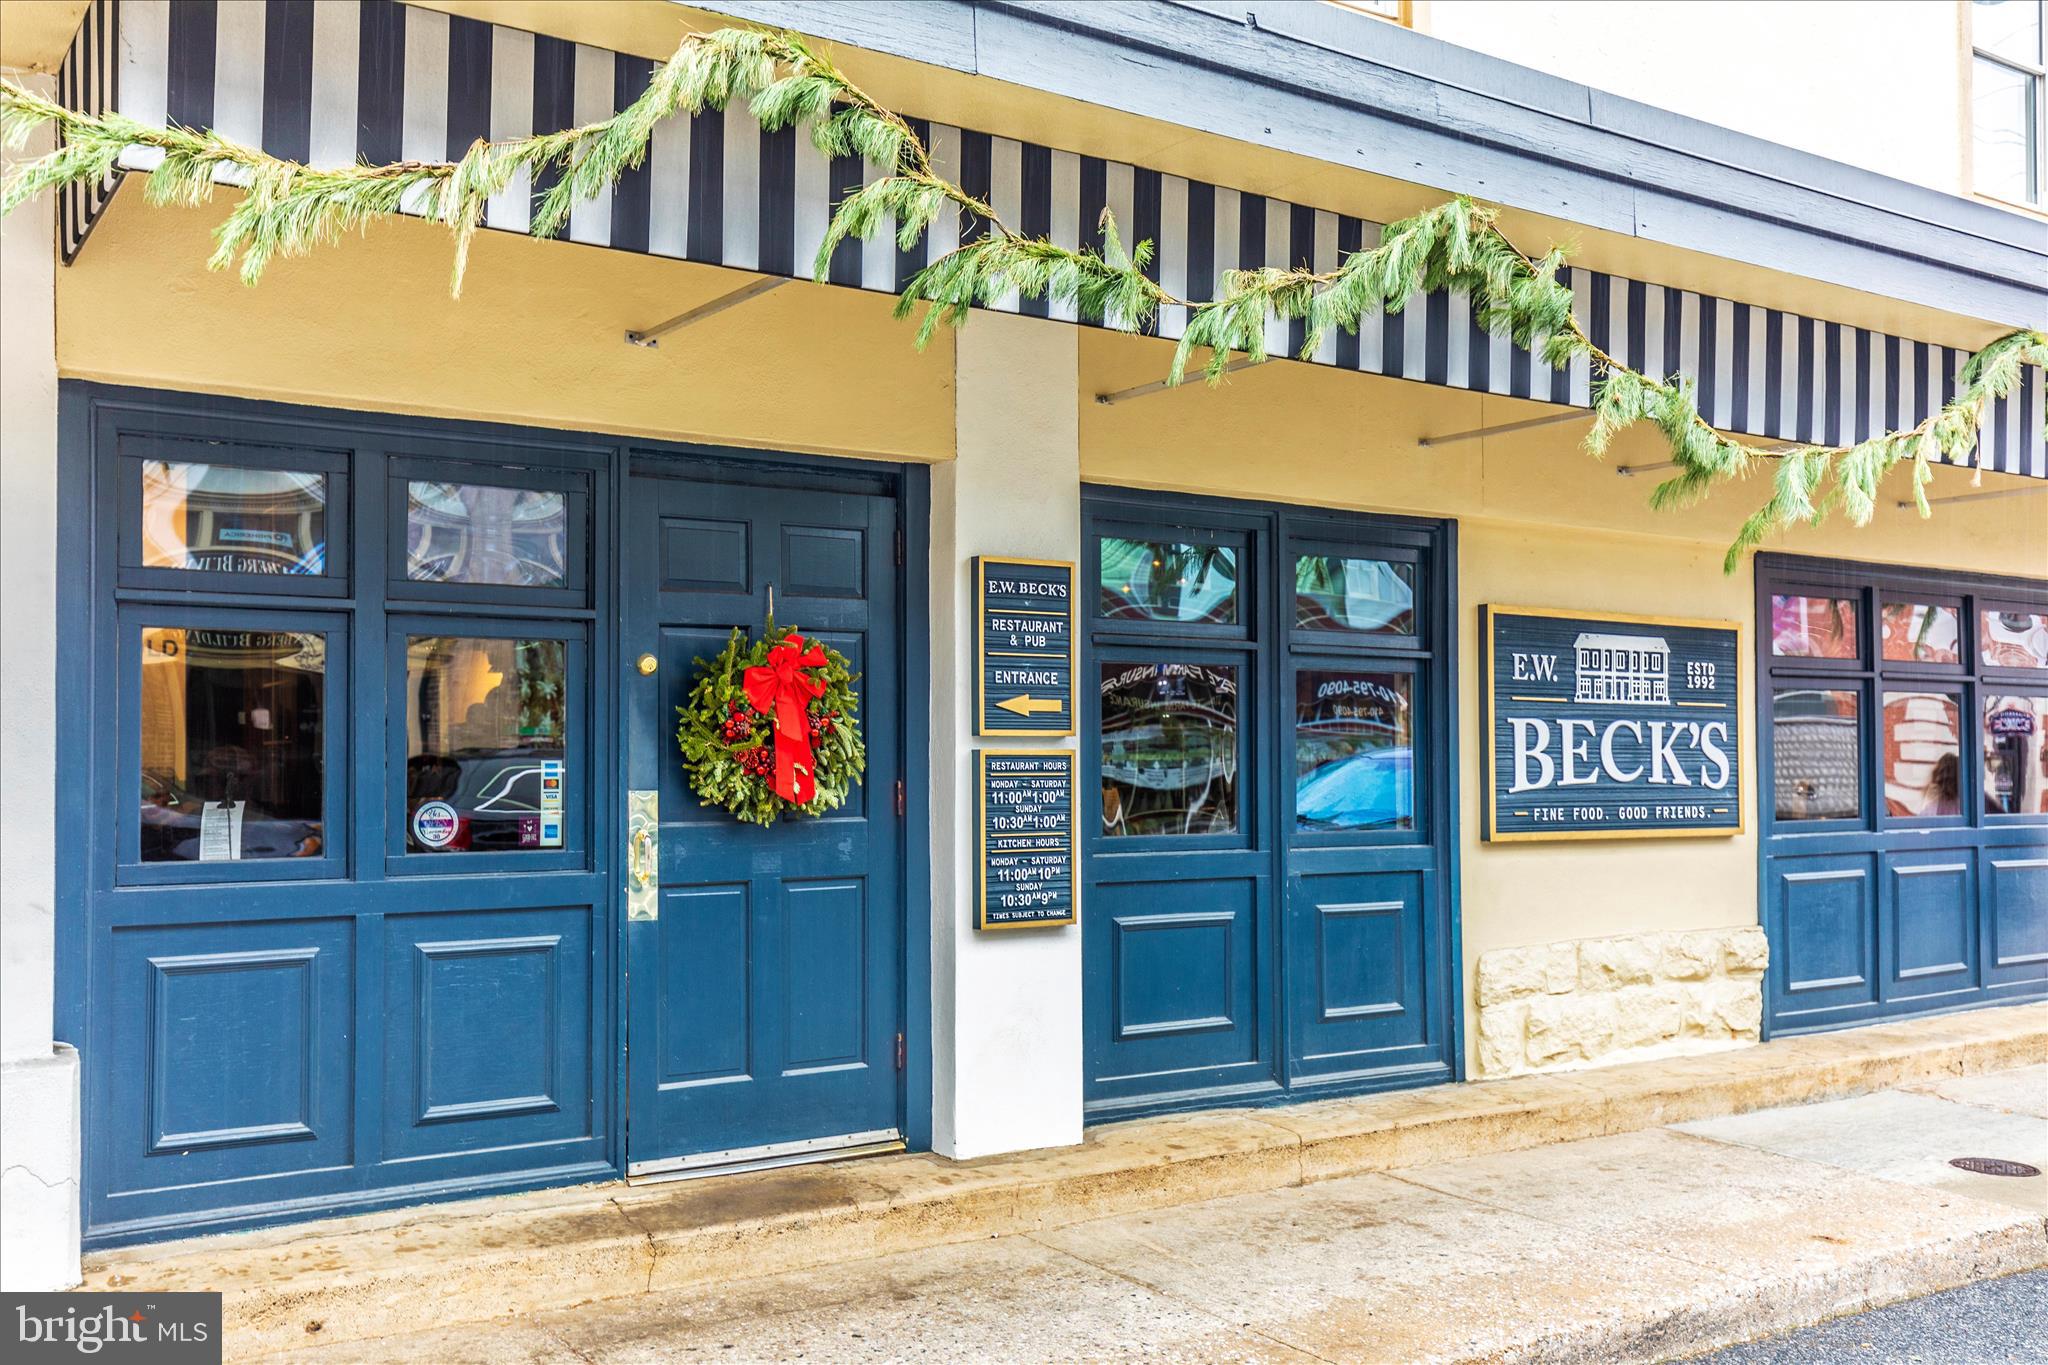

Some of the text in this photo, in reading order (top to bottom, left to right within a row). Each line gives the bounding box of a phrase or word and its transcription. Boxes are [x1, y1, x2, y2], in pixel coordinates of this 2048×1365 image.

[988, 580, 1067, 598] E.W. BECK'S
[992, 618, 1064, 634] RESTAURANT
[1009, 634, 1046, 648] & PUB
[1512, 652, 1558, 682] E.W.
[1686, 661, 1716, 676] ESTD
[995, 670, 1059, 686] ENTRANCE
[1686, 675, 1716, 690] 1992
[1507, 717, 1730, 794] BECK'S
[991, 761, 1067, 771] RESTAURANT HOURS
[991, 780, 1019, 789] MONDAY
[1031, 779, 1067, 788] SATURDAY
[1015, 804, 1042, 814] SUNDAY
[1534, 805, 1712, 821] FINE FOOD. GOOD FRIENDS.
[997, 838, 1060, 848] KITCHEN HOURS
[991, 857, 1019, 867] MONDAY
[1031, 855, 1067, 865] SATURDAY
[1015, 882, 1043, 892] SUNDAY
[1011, 911, 1035, 919] SUBJECT
[1037, 910, 1045, 918] TO
[1046, 909, 1067, 917] CHANGE
